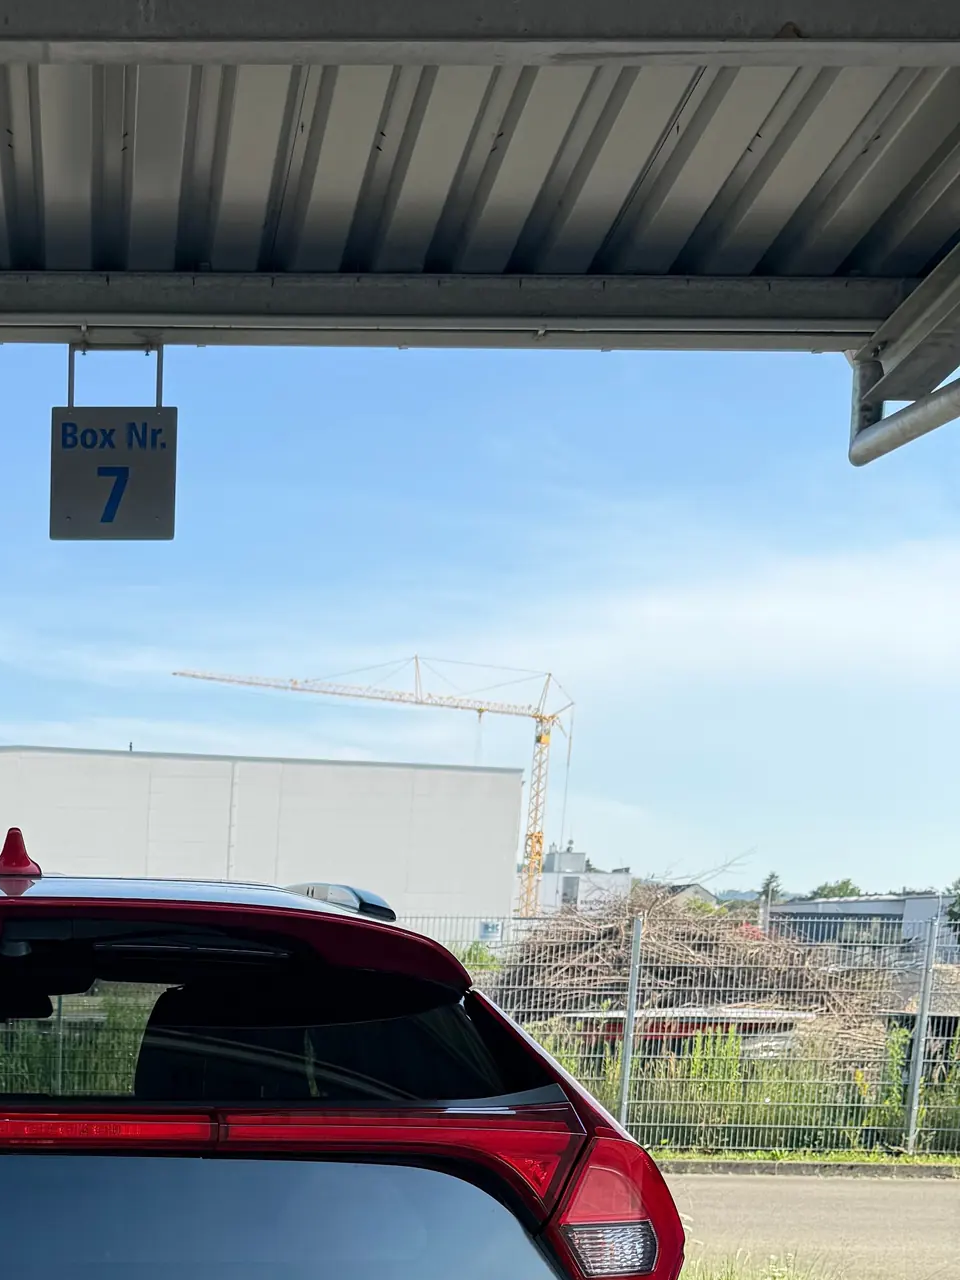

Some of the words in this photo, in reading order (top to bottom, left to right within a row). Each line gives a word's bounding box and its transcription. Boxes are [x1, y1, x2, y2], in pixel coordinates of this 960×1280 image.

[61, 421, 117, 450] Box
[126, 421, 167, 451] Nr.
[97, 466, 130, 523] 7
